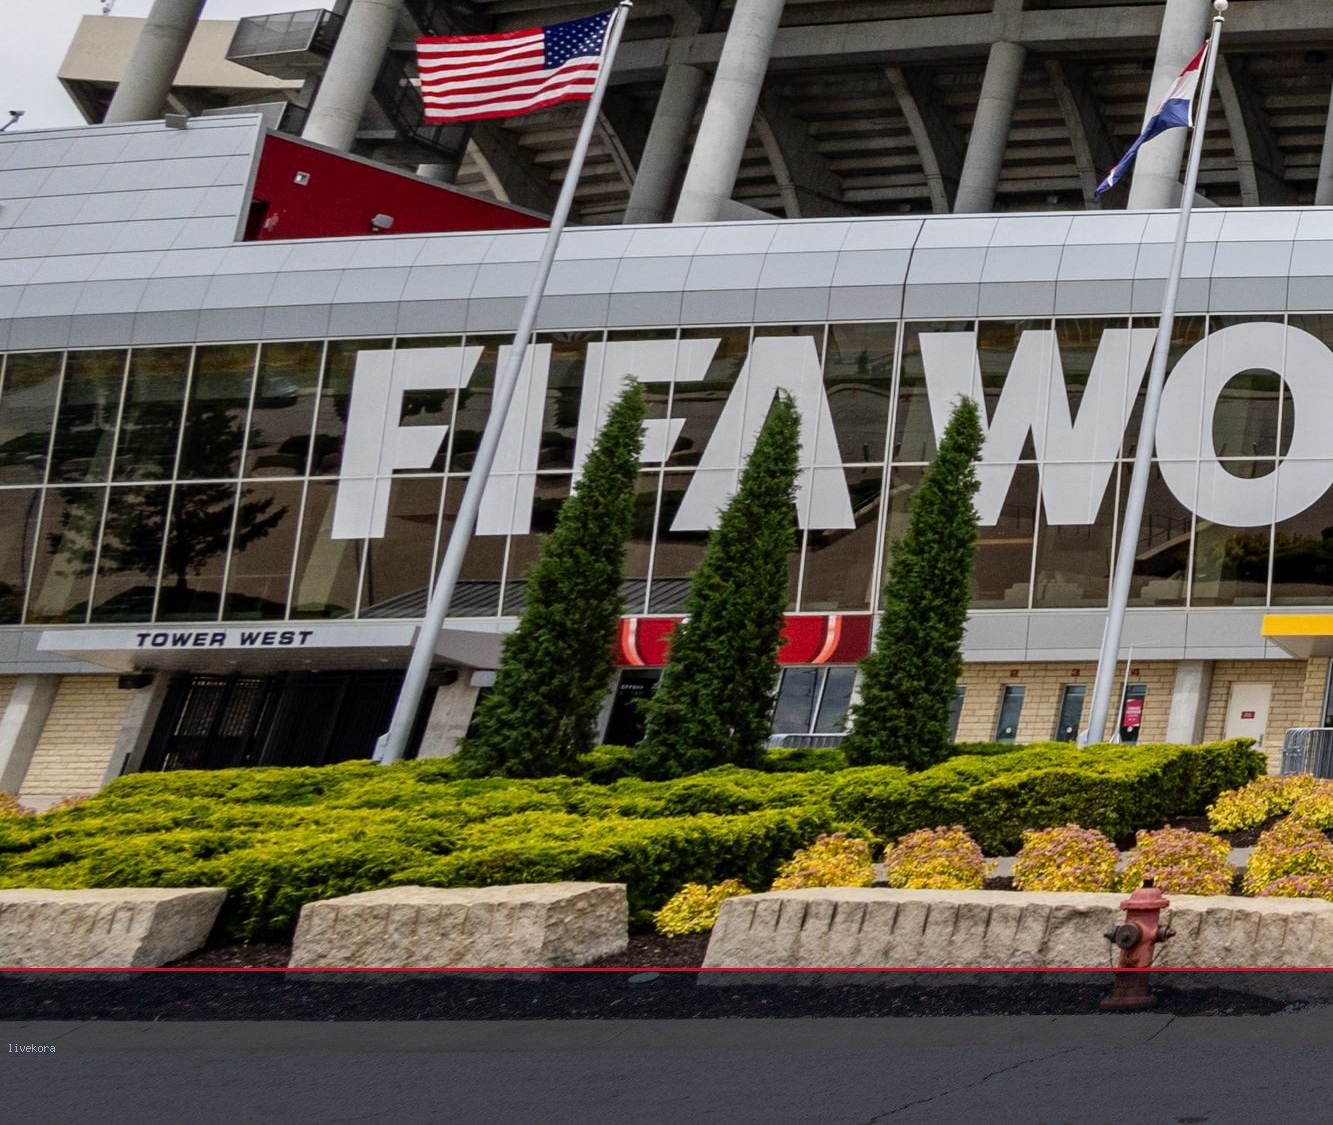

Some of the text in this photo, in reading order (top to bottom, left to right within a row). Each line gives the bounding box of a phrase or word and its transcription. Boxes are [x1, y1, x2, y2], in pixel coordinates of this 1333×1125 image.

[331, 335, 856, 539] FIFA
[137, 631, 313, 647] TOWER WEST
[1071, 668, 1080, 677] 3
[1131, 668, 1140, 676] 4
